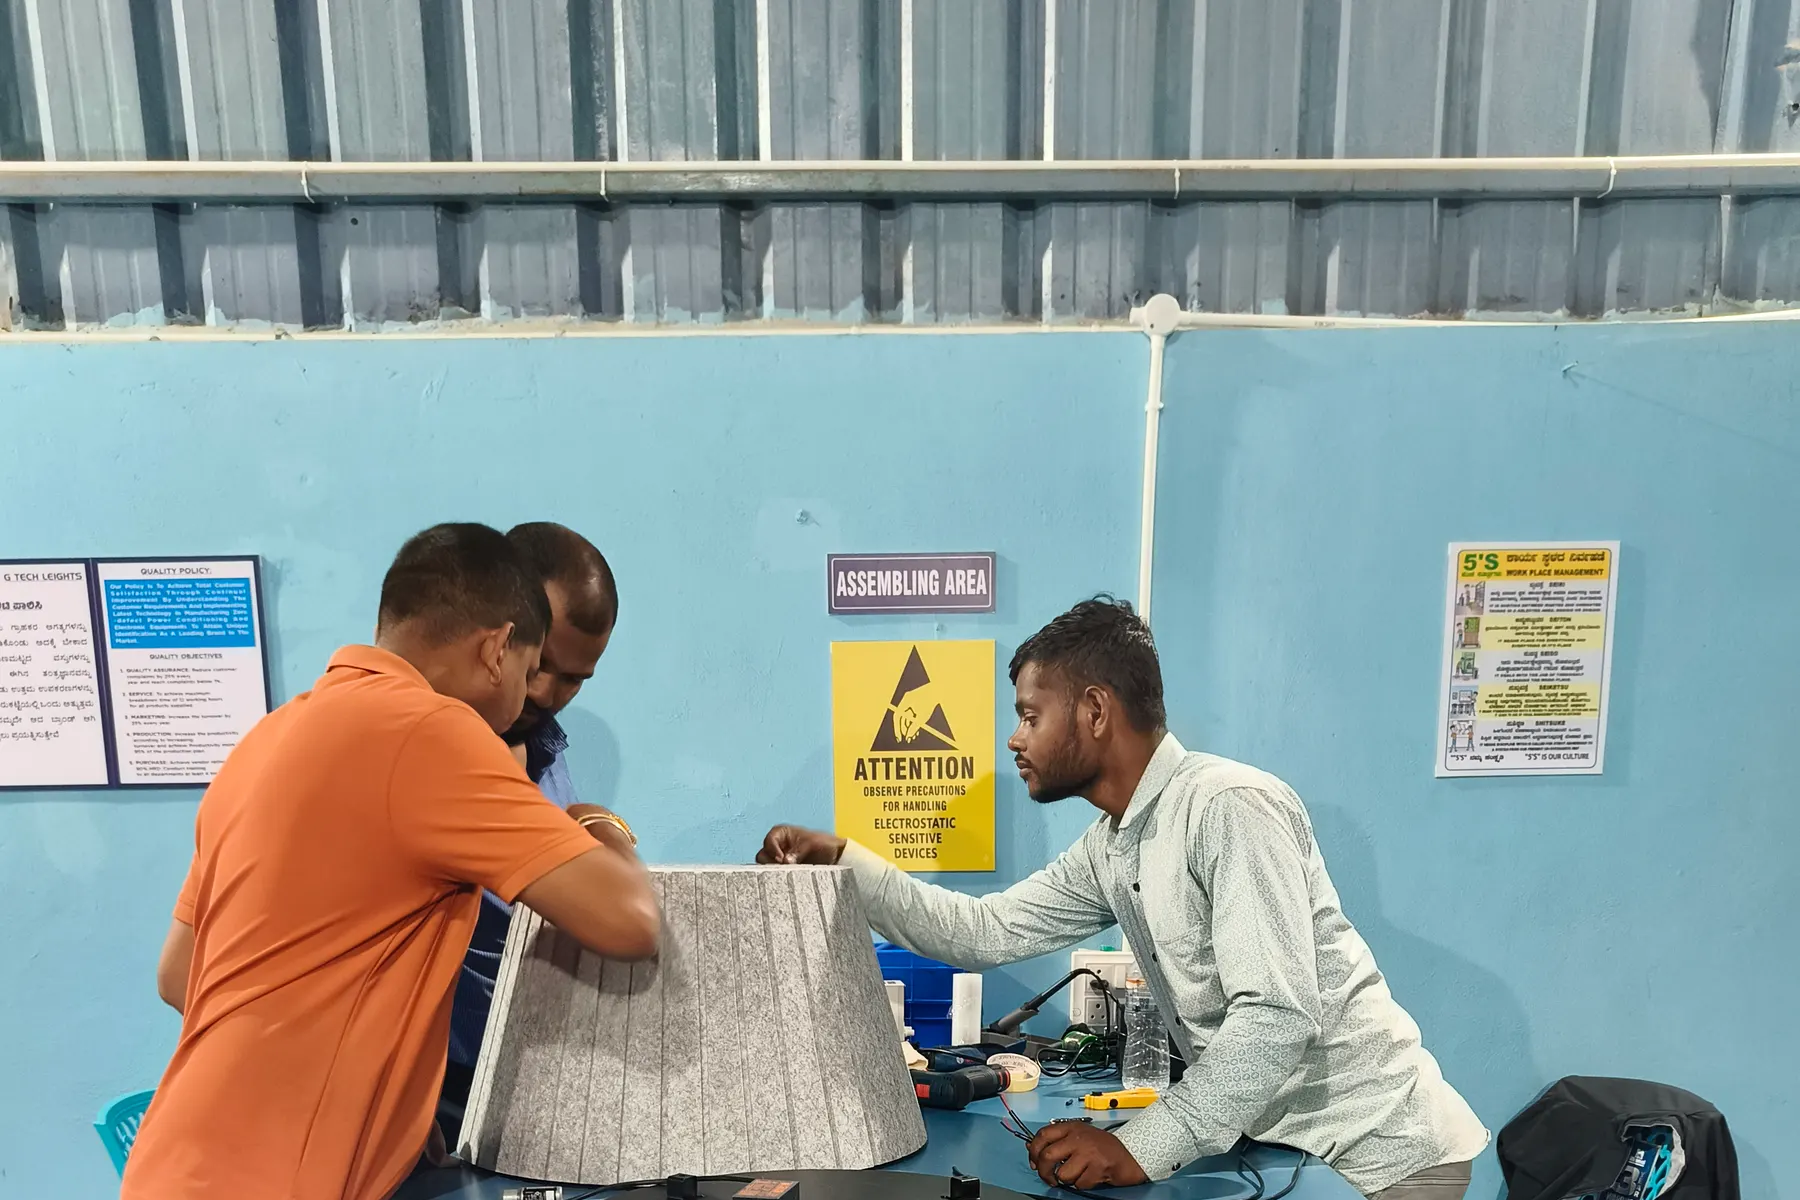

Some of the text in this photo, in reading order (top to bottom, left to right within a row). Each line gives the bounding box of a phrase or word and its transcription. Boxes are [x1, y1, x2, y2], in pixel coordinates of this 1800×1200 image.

[1463, 553, 1499, 571] 5'S
[4, 572, 82, 581] G TECH LEIGHTS
[1554, 568, 1604, 576] MANAGEMENT
[836, 569, 987, 597] ASSEMBLING AREA
[13, 601, 43, 610] ಪಾಲಿಸಿ
[854, 756, 974, 781] ATTENTION
[863, 785, 966, 797] OBSERVE PRECAUTIONS
[883, 801, 947, 812] FOR HANDLING
[874, 817, 956, 829] ELECTROSTATIC
[889, 833, 942, 844] SENSITIVE
[894, 847, 938, 859] DEVICES
[1615, 1165, 1640, 1196] 3
